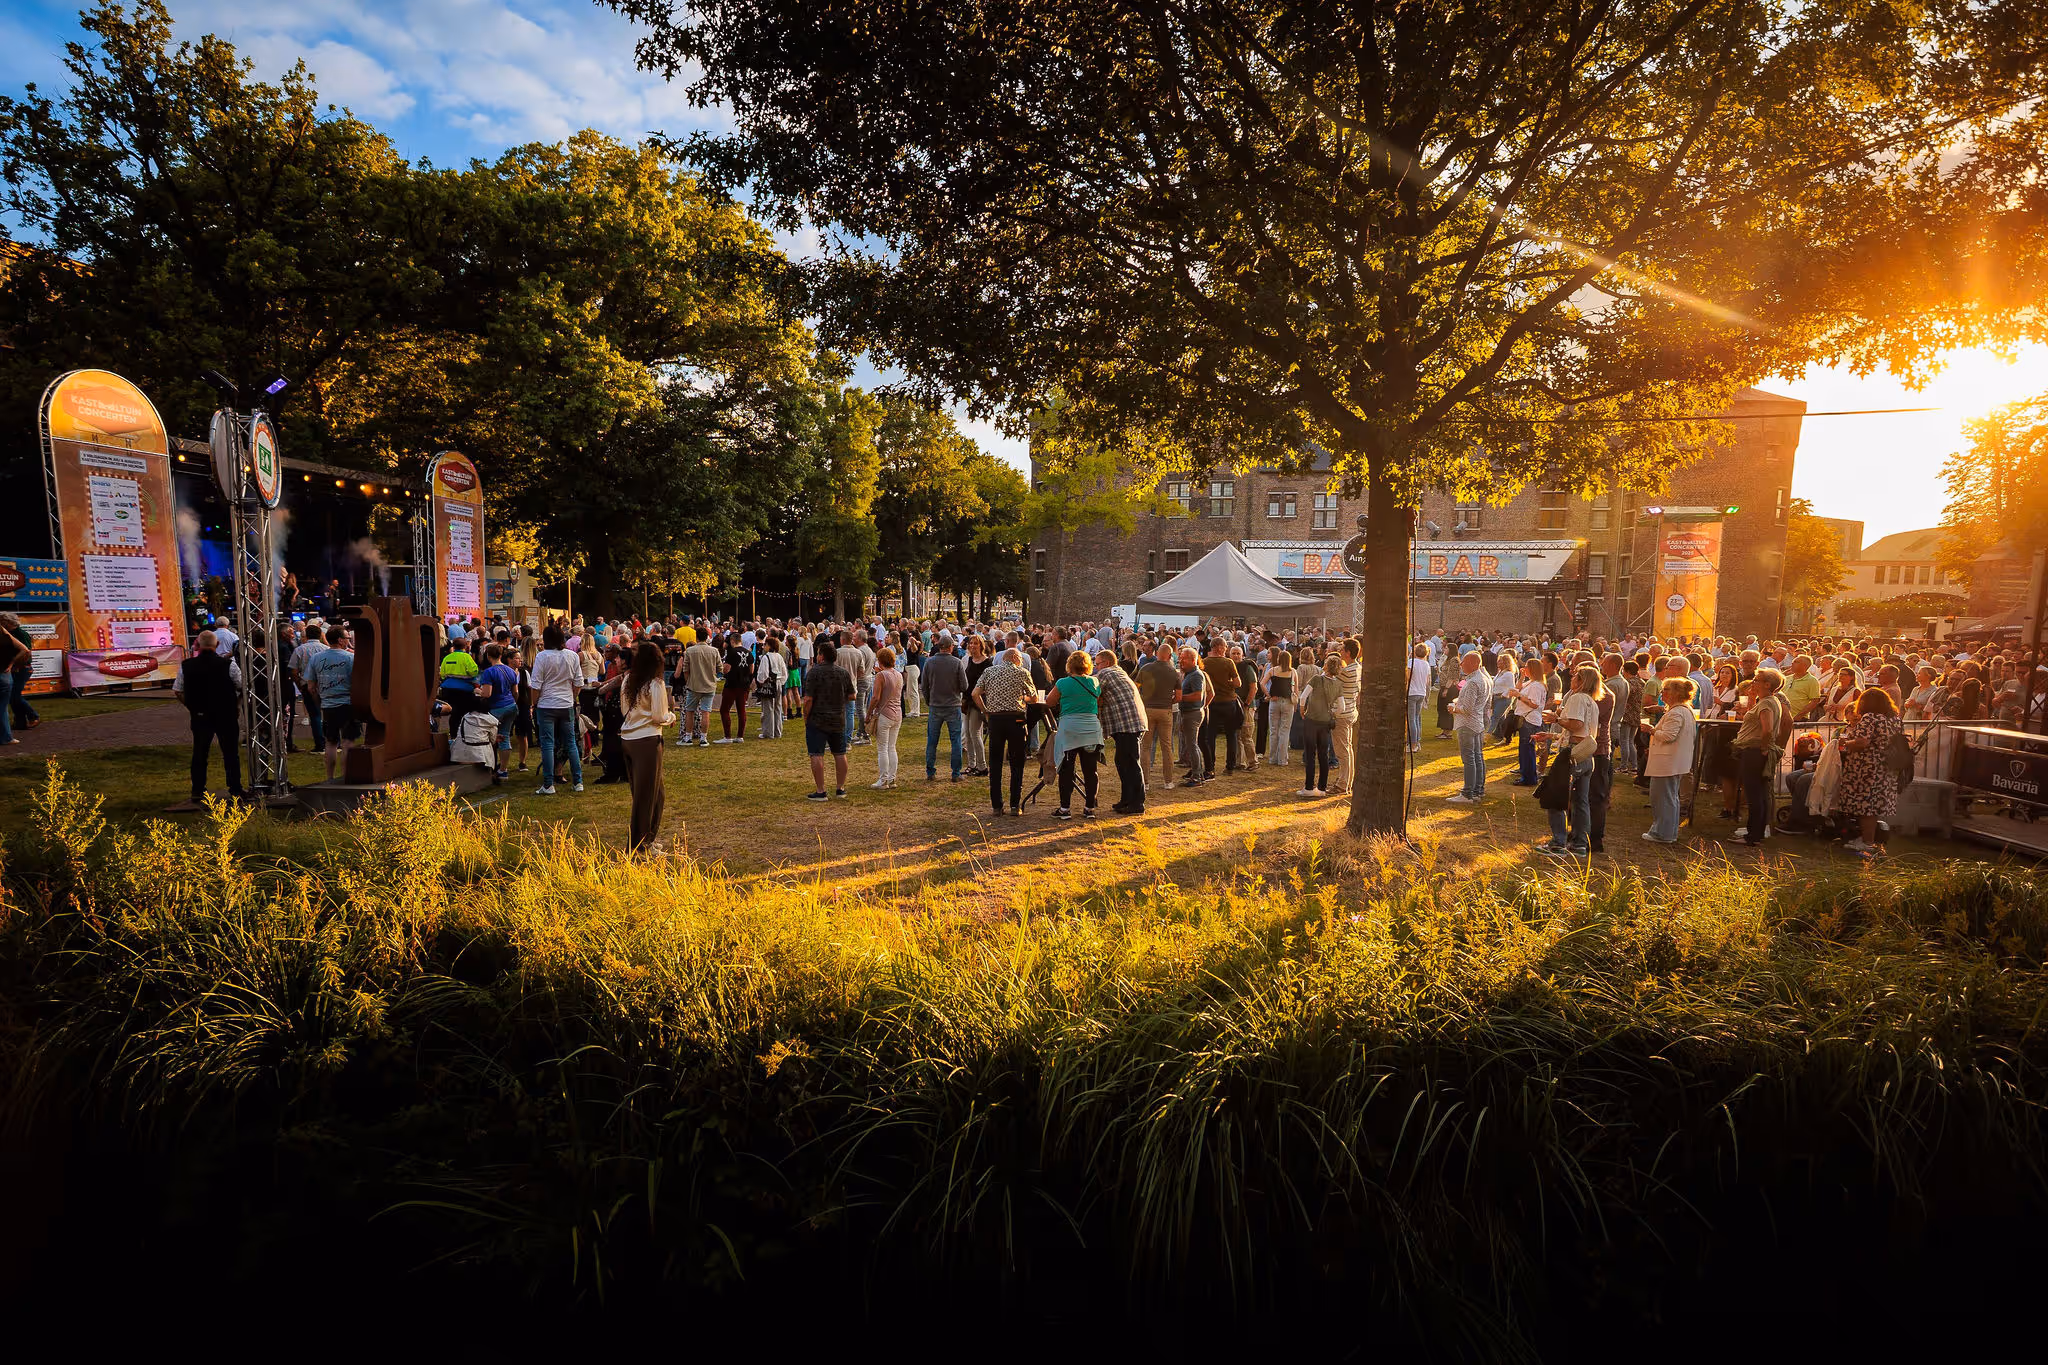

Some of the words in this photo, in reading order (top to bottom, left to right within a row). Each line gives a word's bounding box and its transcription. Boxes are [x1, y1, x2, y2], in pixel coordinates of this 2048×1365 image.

[78, 406, 137, 424] CONCERTEN
[1303, 554, 1347, 575] BA
[1428, 555, 1500, 576] BAR
[1992, 773, 2039, 795] Bavaria
